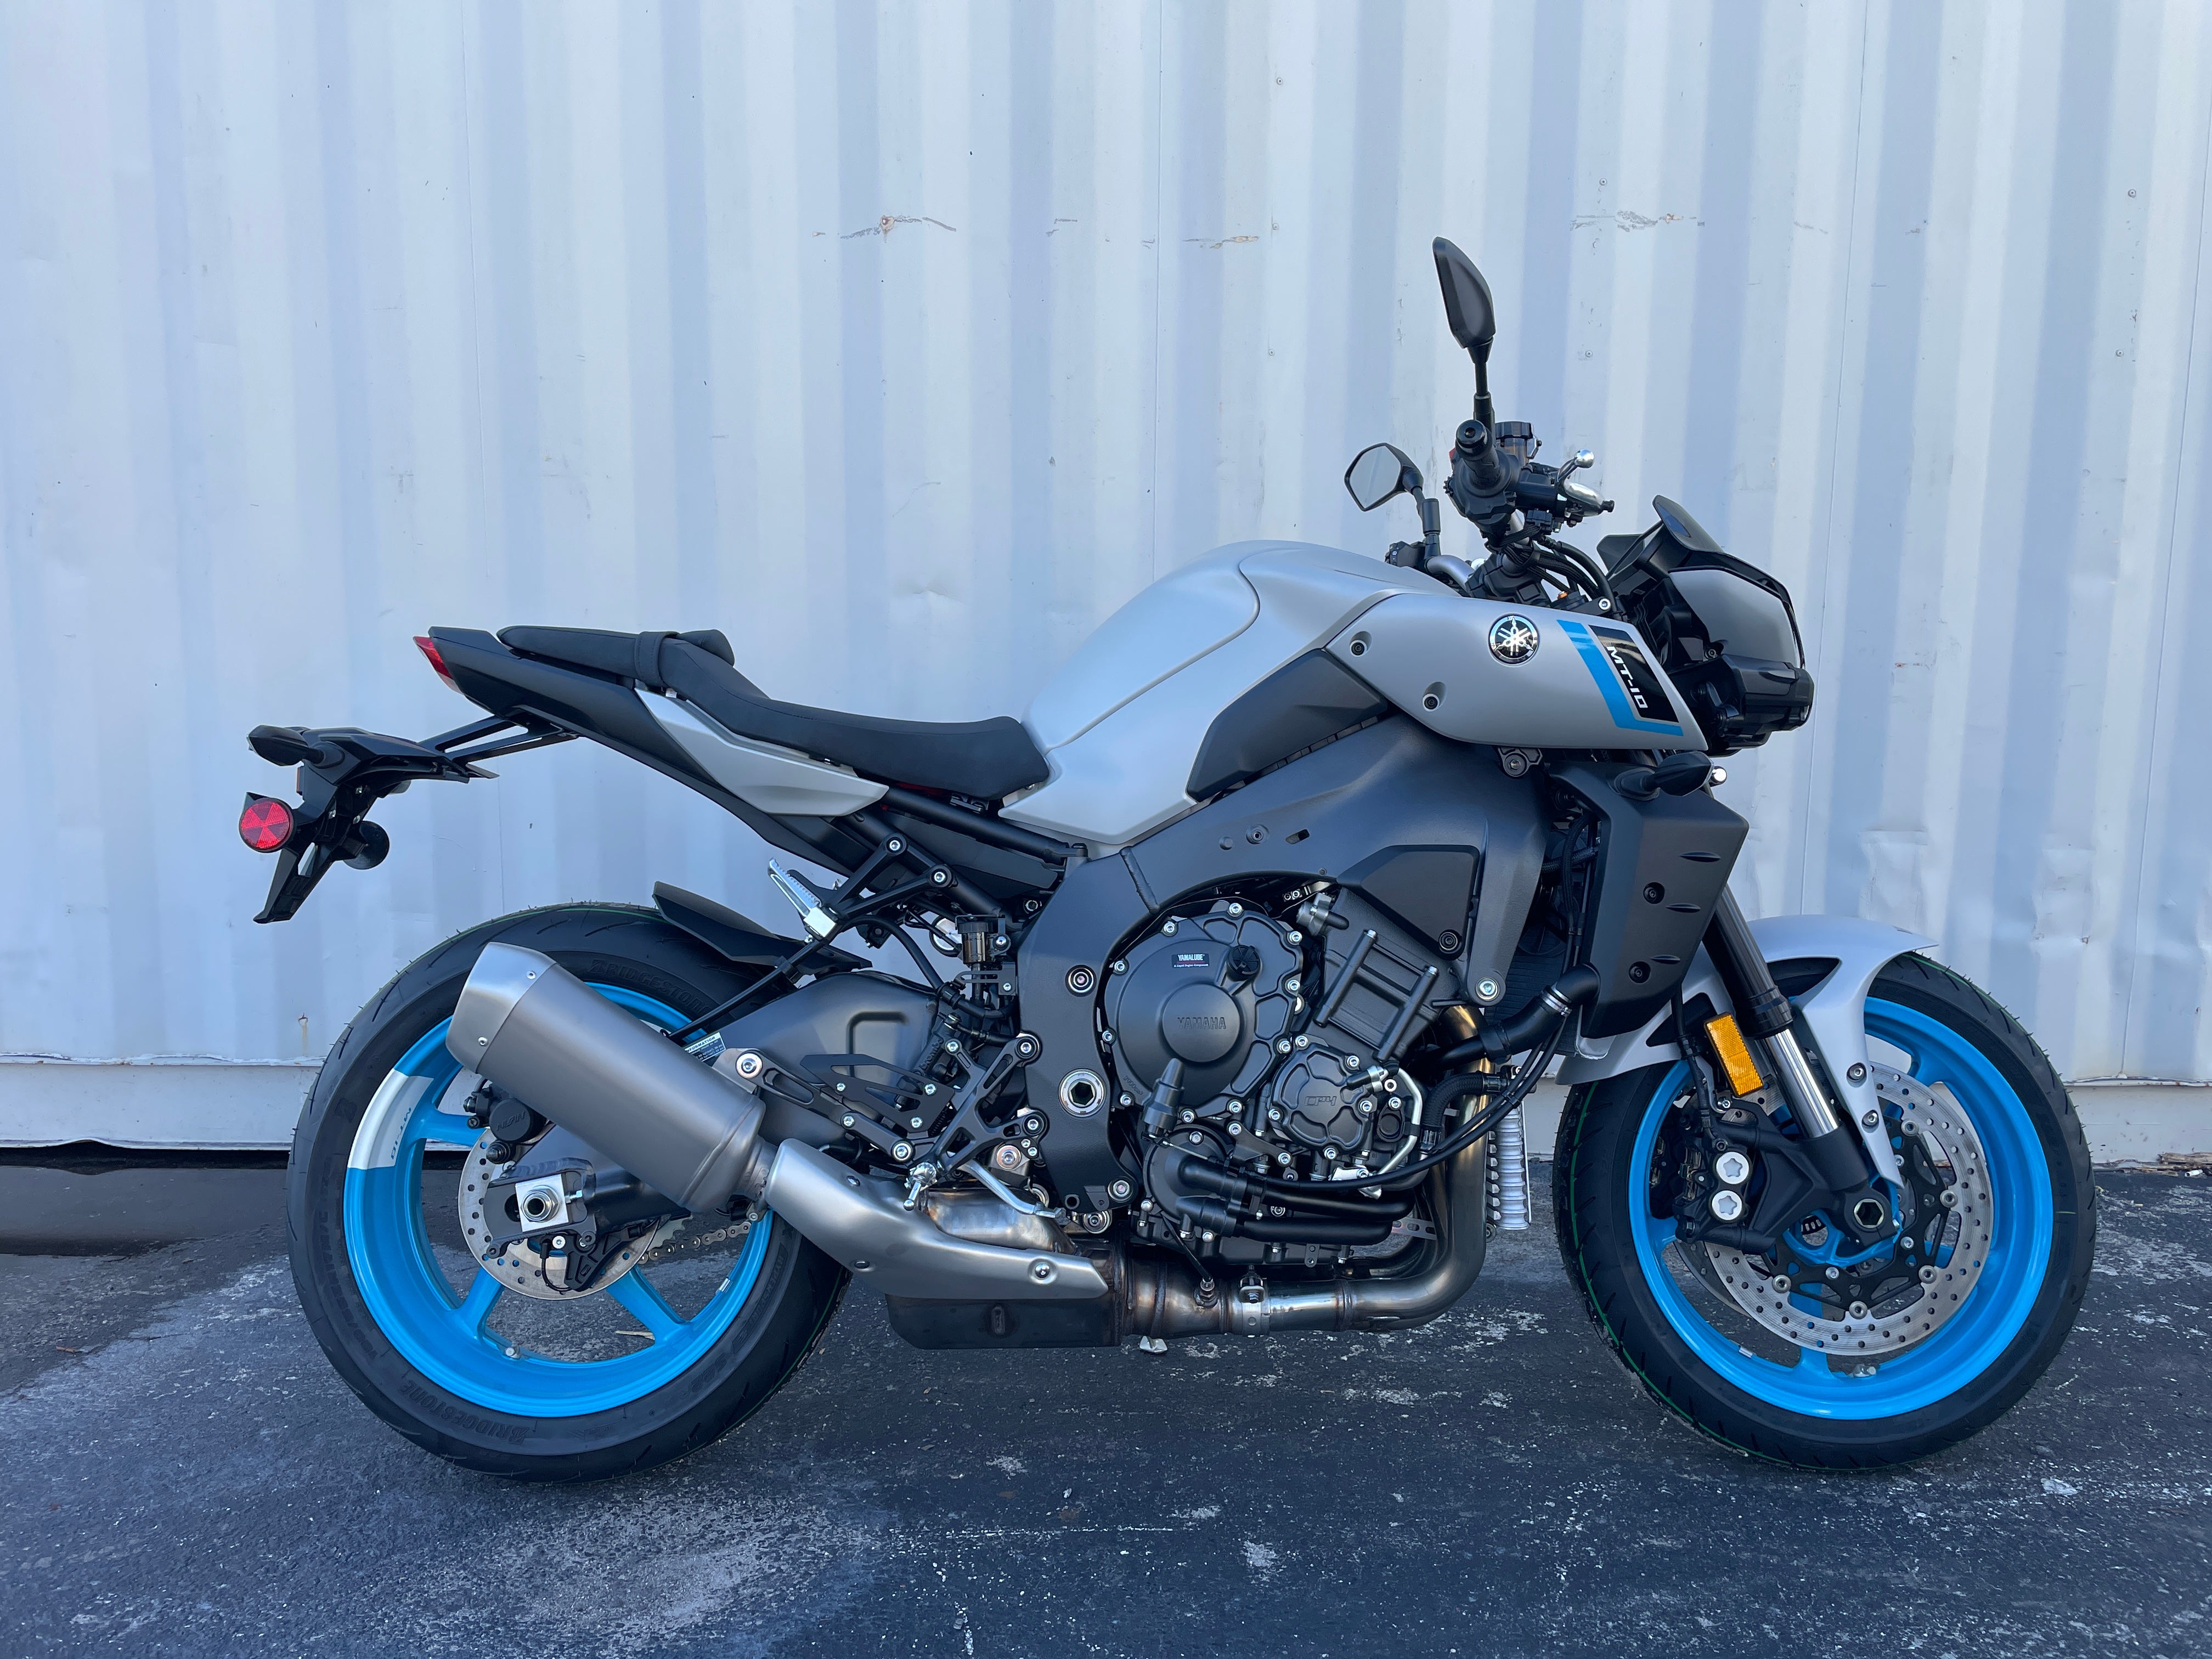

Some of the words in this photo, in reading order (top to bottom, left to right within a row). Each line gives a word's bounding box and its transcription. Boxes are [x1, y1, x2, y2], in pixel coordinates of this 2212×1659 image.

[1606, 646, 1648, 708] MT-10
[1177, 1015, 1227, 1030] YAMAHA
[1304, 1095, 1337, 1107] CP4
[391, 1107, 412, 1160] MT-10
[397, 1379, 531, 1445] BRIDGESTONE
